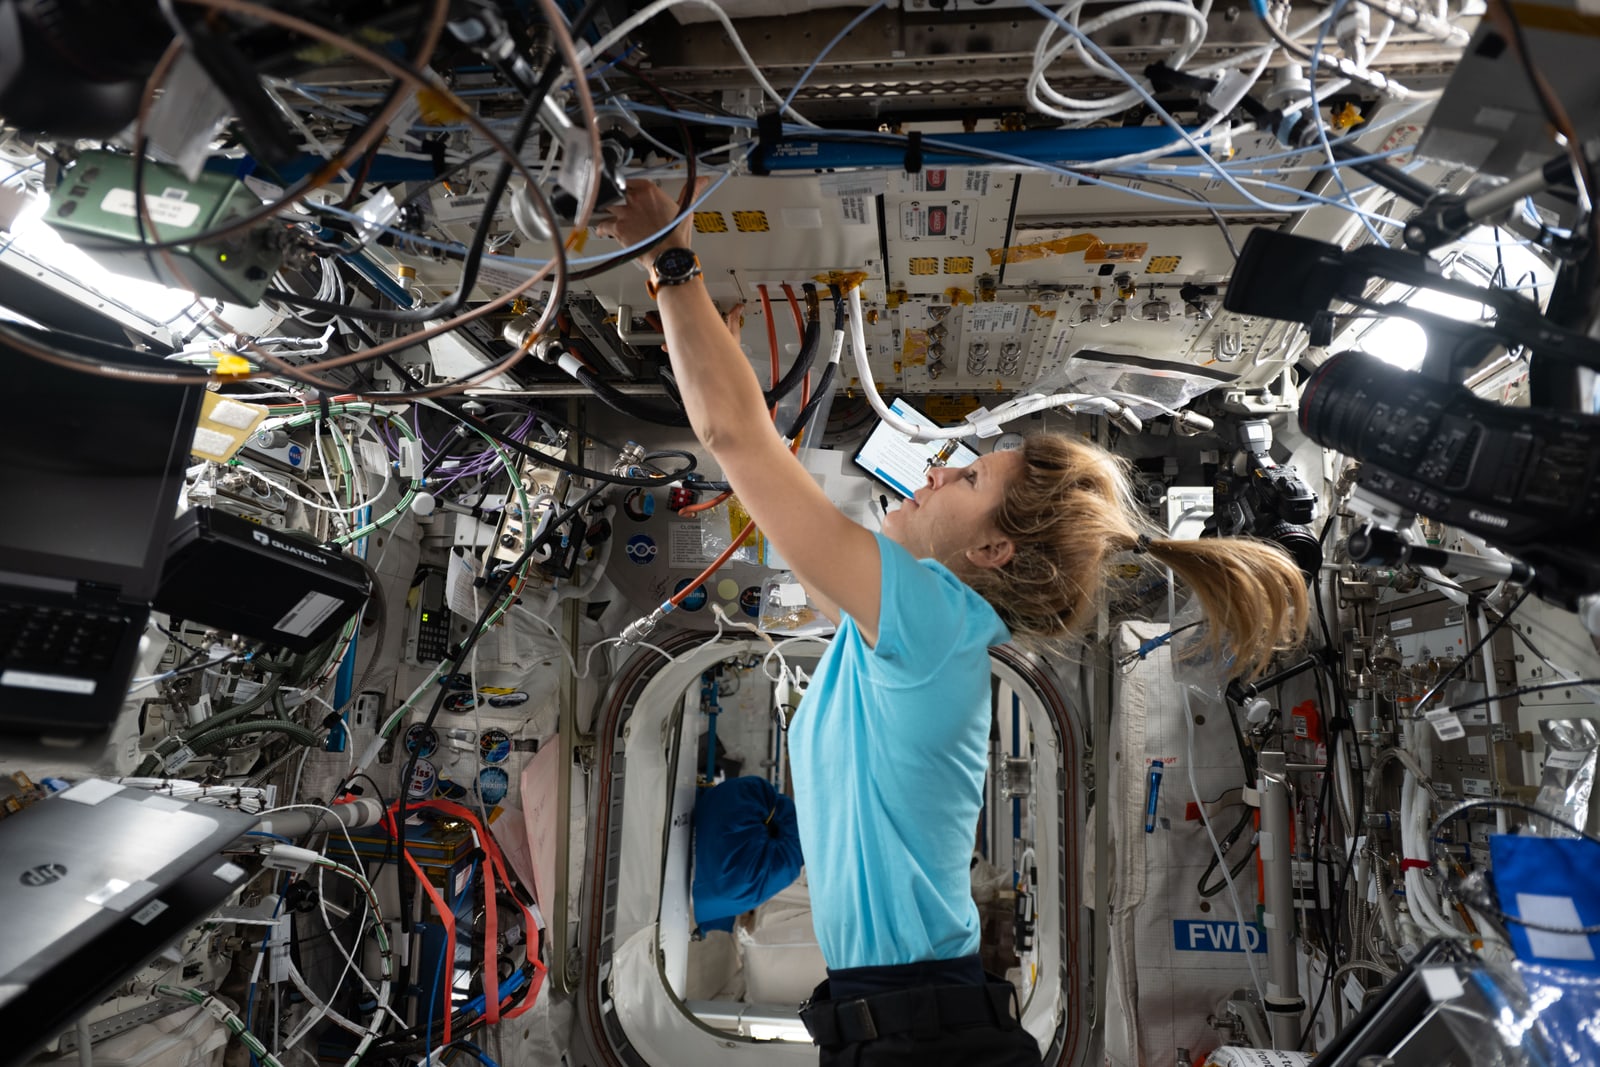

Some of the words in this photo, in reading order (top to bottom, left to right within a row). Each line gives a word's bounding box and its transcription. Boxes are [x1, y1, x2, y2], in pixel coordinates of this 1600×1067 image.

[933, 212, 941, 230] DANGER
[1468, 509, 1509, 528] Canon
[271, 539, 328, 565] QUATECH
[1188, 924, 1261, 952] FWD
